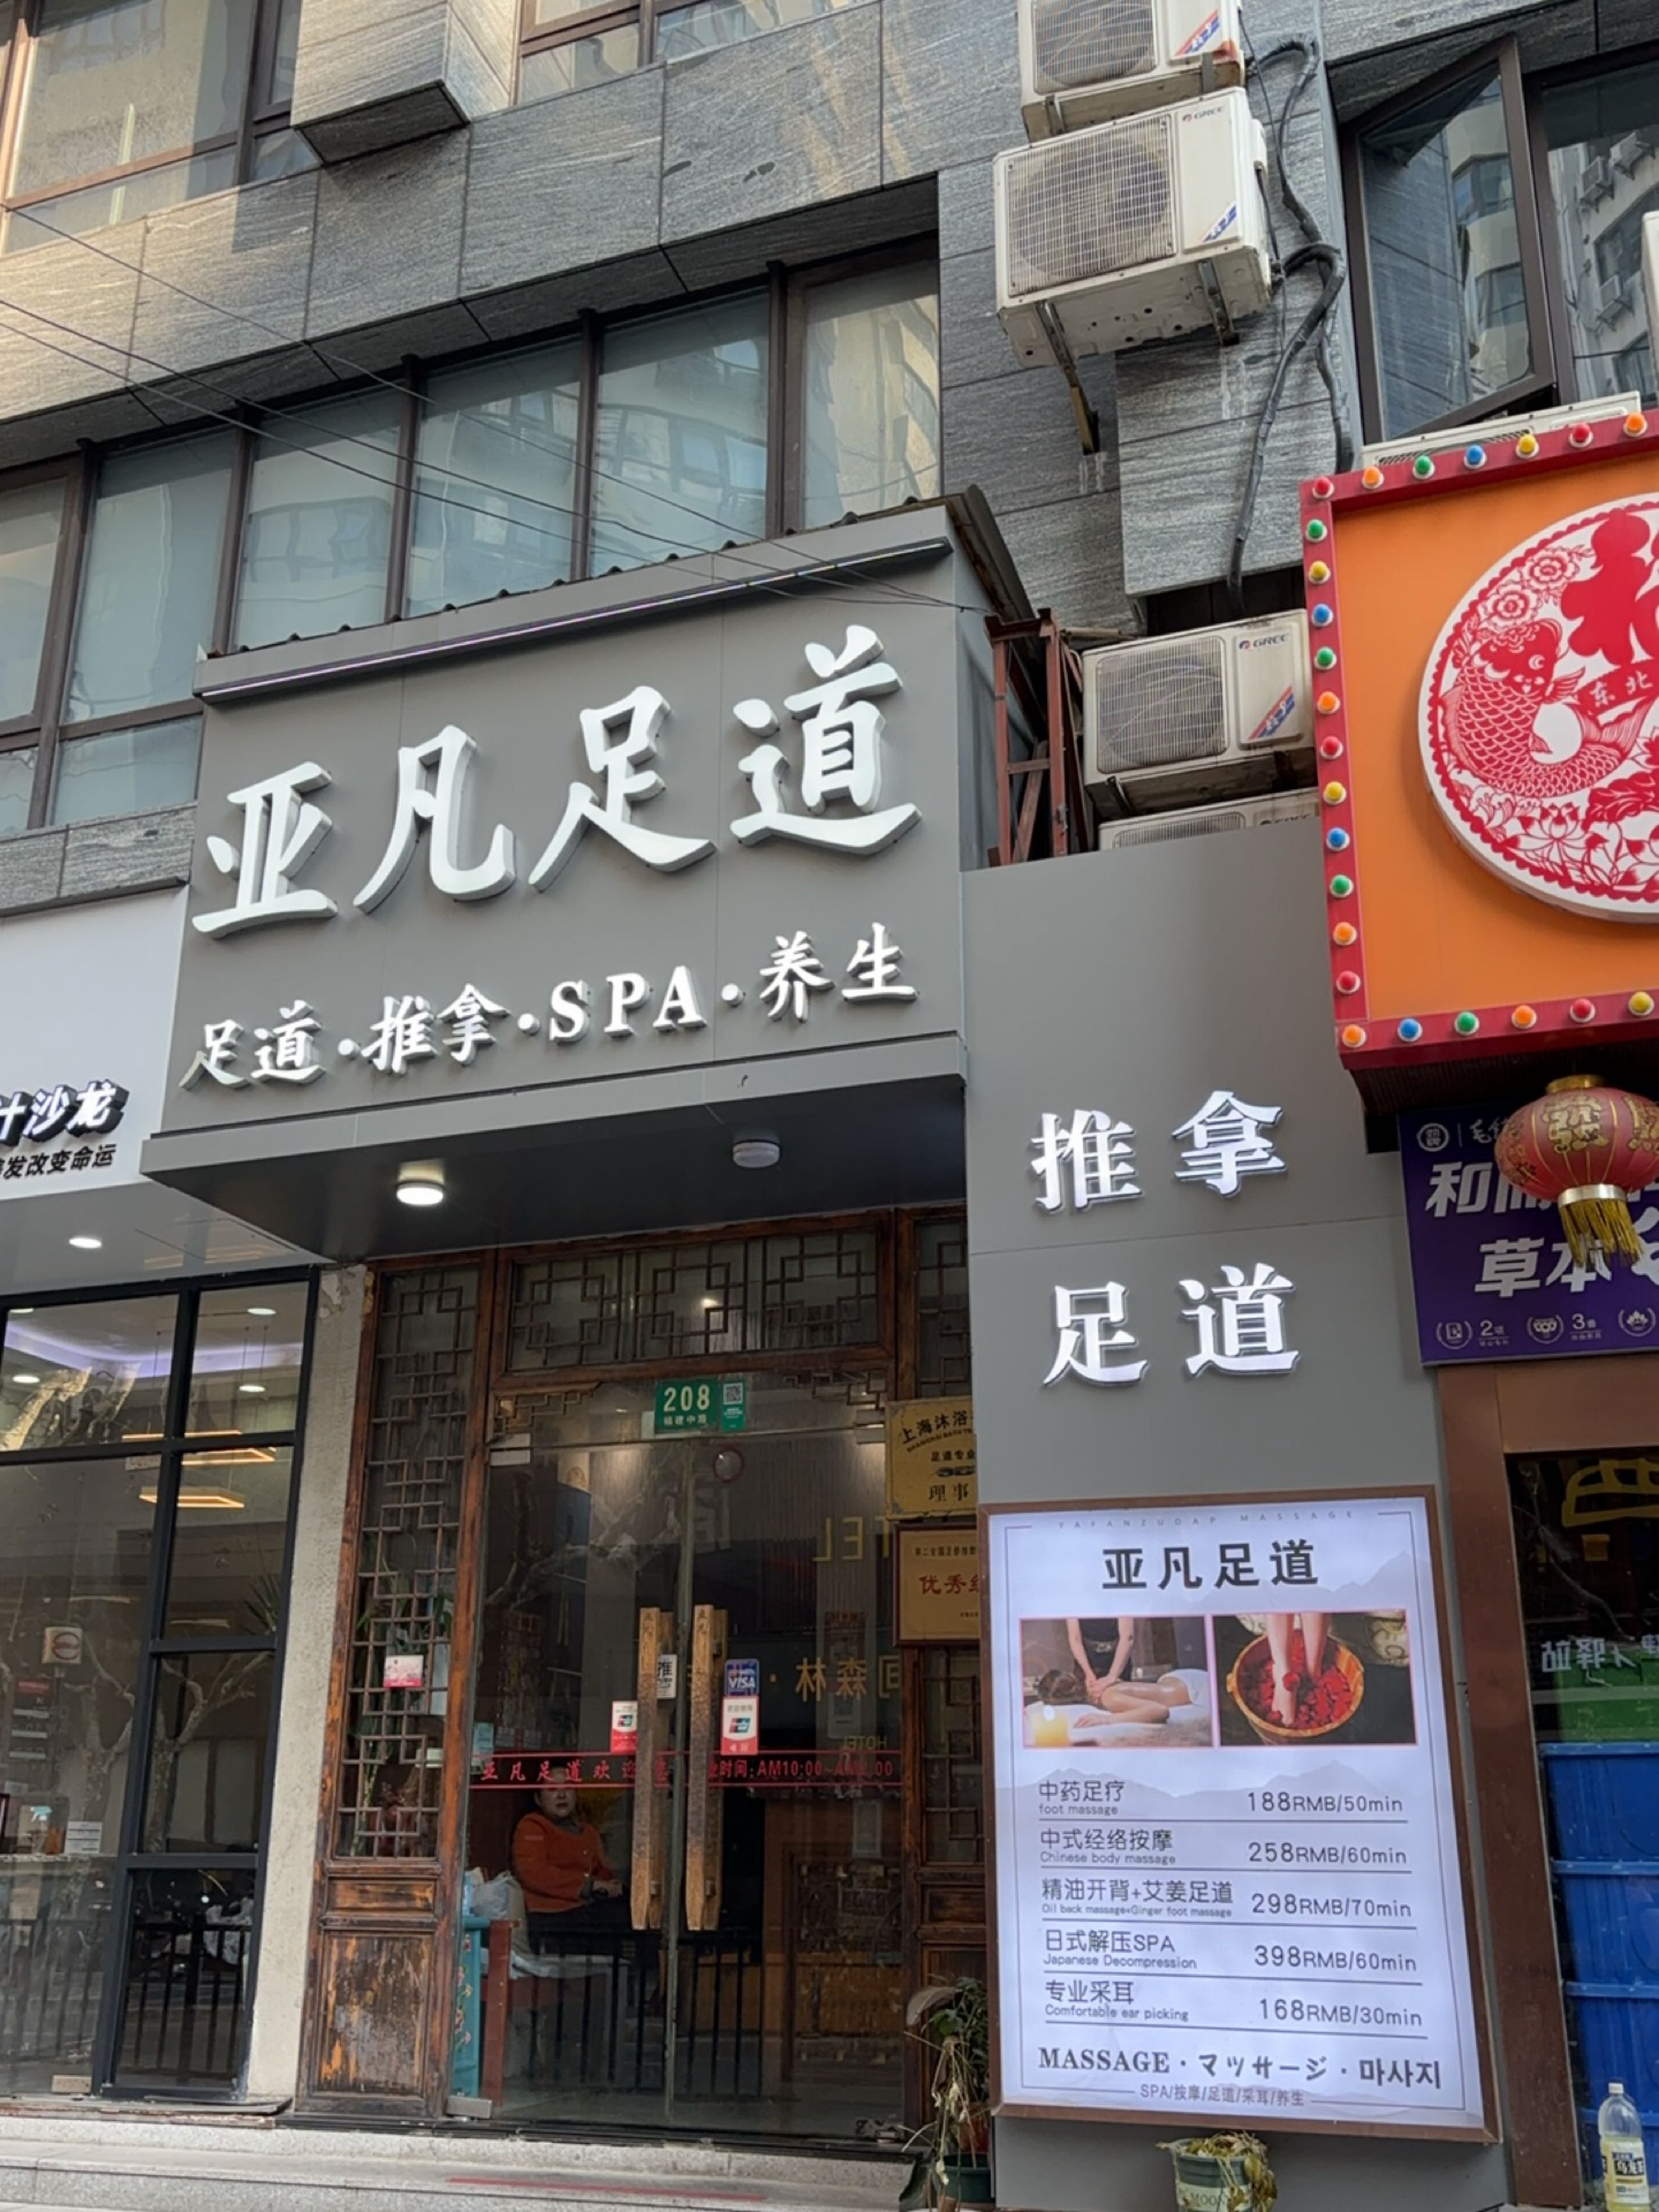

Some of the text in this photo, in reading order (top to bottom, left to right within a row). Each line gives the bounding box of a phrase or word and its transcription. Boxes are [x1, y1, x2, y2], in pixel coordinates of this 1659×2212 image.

[1589, 670, 1653, 708] 东北
[191, 625, 922, 940] 亚凡足道
[0, 1144, 116, 1179] 发改变命运
[1030, 1090, 1287, 1212] 推拿
[1042, 1262, 1301, 1387] 足道
[663, 1384, 710, 1413] 208
[1102, 1539, 1318, 1590] 亚凡足道
[728, 1676, 756, 1690] VISA
[1039, 1780, 1125, 1802] 中药足疗
[1248, 1791, 1403, 1813] 188RMB/50min
[1039, 1804, 1118, 1815] foot massage
[1041, 1829, 1173, 1851] 中式经络按摩
[1040, 1851, 1176, 1865] Chinese body massage
[1248, 1842, 1407, 1864] 258RMB/60min
[1041, 1878, 1233, 1903] 精油开背+艾姜足道
[1167, 1905, 1187, 1916] foot
[1251, 1893, 1411, 1917] 298RMB/70min
[1046, 1929, 1176, 1953] 日式解压SPA
[1043, 1953, 1197, 1969] Japanese Decompression
[1254, 1945, 1416, 1971] 398RMB/60min
[1045, 1979, 1134, 2005] 专业采耳
[1045, 2004, 1189, 2022] Comfortable ear picking
[1260, 1998, 1422, 2026] 168RMB/30min
[1038, 2047, 1171, 2074] MASSAGE
[1360, 2058, 1441, 2089] 마사지
